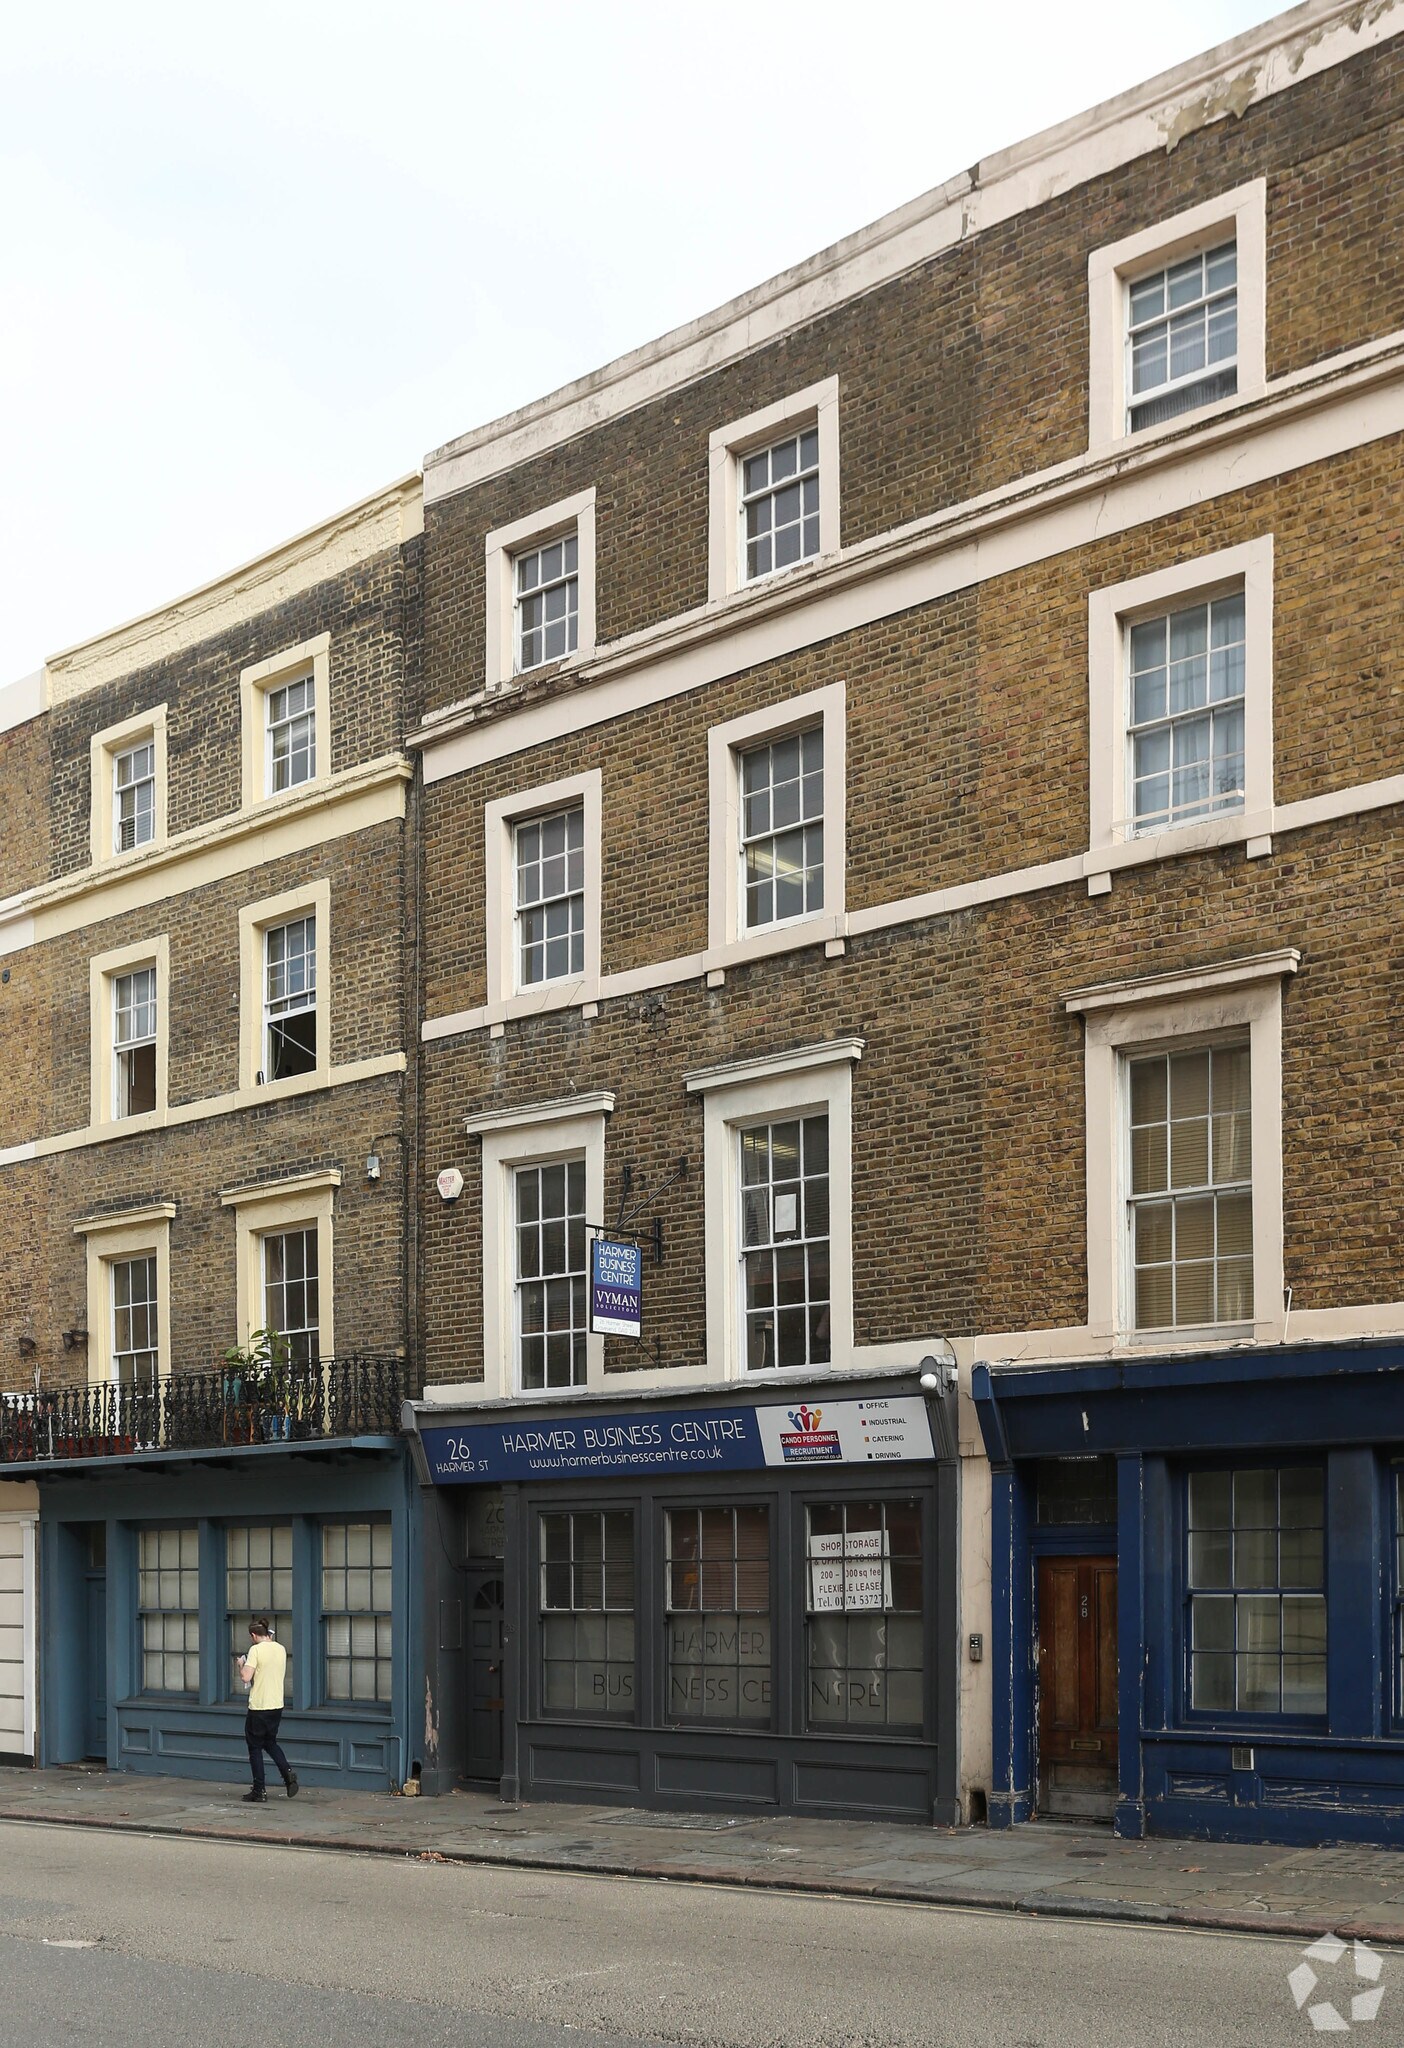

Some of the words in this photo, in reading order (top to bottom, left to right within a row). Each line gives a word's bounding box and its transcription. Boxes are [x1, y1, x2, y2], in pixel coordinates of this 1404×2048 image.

[599, 1244, 636, 1260] HARMER
[599, 1257, 635, 1273] BUSINESS
[601, 1270, 634, 1286] CENTRE
[597, 1290, 638, 1307] VYMAN
[596, 1303, 638, 1314] SOLICITORS
[869, 1418, 907, 1426] INDUSTRIAL
[502, 1431, 576, 1453] HARMER
[584, 1425, 662, 1448] BUSINESS
[670, 1419, 746, 1442] CENTRE
[781, 1436, 801, 1444] CANDO
[803, 1434, 838, 1443] PERSONNEL
[447, 1438, 470, 1460] 26
[790, 1446, 833, 1456] RECRUITMENT
[875, 1451, 901, 1459] DRIVING
[530, 1445, 723, 1468] www.harmerbusinesscentre.co.uk
[436, 1461, 475, 1473] HARMER
[478, 1460, 489, 1471] ST
[820, 1571, 833, 1579] 200
[870, 1568, 882, 1576] fee
[819, 1583, 853, 1593] FLEXIBE
[817, 1597, 832, 1607] Tel.
[835, 1596, 856, 1606] 0174
[1081, 1595, 1088, 1618] 28
[673, 1632, 765, 1654] HARMER
